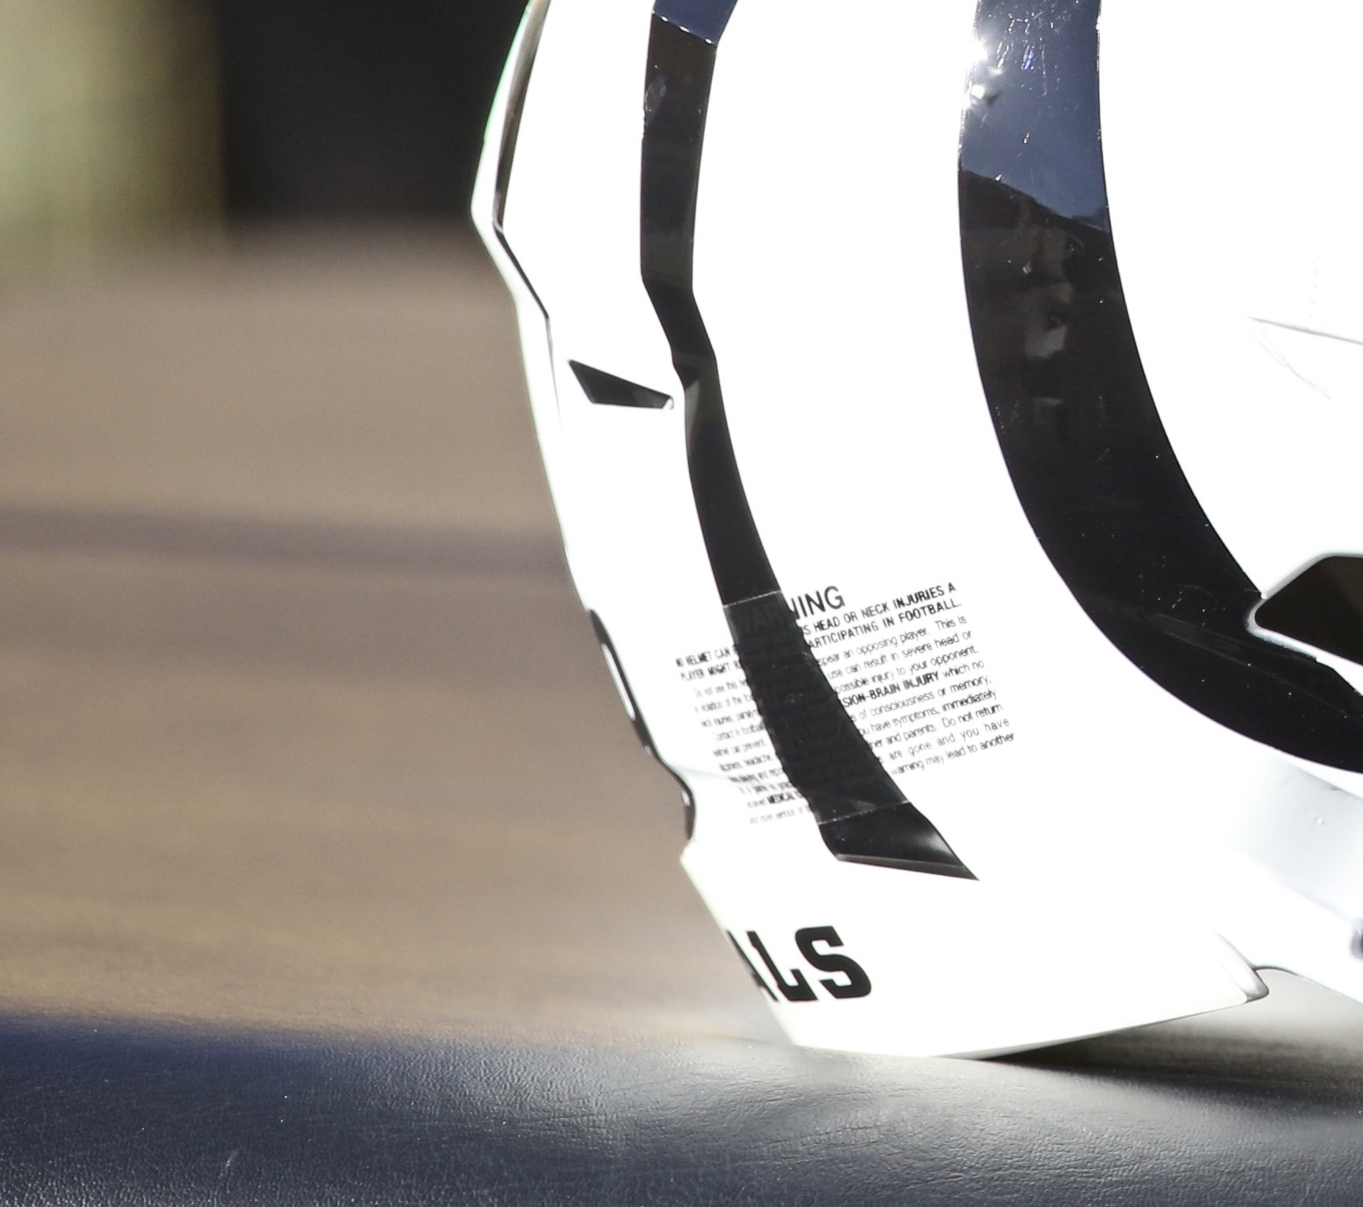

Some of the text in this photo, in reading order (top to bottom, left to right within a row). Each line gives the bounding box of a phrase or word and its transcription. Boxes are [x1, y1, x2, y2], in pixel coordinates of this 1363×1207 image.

[806, 620, 879, 649] ARTICIPATING
[882, 616, 895, 628] IN
[898, 598, 962, 623] FOOTBALL.
[813, 616, 840, 633] HEAD
[843, 611, 858, 624] OR
[861, 601, 890, 619] NECK
[892, 585, 945, 609] INJURIES
[948, 582, 957, 593] A
[827, 669, 843, 680] use
[845, 663, 862, 675] can
[863, 653, 889, 669] result
[890, 651, 900, 661] in
[901, 642, 933, 658] severe
[934, 635, 960, 652] head
[961, 630, 972, 642] or
[844, 650, 854, 659] an
[857, 636, 899, 656] opposing
[934, 616, 957, 631] This
[958, 615, 967, 624] is
[834, 677, 869, 694] possible
[871, 669, 895, 684] injury
[896, 666, 906, 676] to
[908, 661, 928, 675] your
[930, 645, 979, 667] opponent.
[903, 670, 940, 690] INJURY
[942, 663, 971, 679] which
[972, 659, 985, 670] no
[859, 710, 867, 720] of
[870, 691, 935, 717] consciousness
[937, 686, 947, 697] or
[949, 674, 992, 693] memory,
[870, 721, 892, 732] have
[892, 706, 941, 727] symptoms,
[941, 687, 997, 712] immediately
[885, 732, 902, 746] and
[941, 715, 957, 728] Do
[958, 711, 973, 724] not
[975, 703, 1003, 719] return
[889, 749, 903, 761] are
[908, 741, 932, 757] gone
[937, 733, 956, 746] and
[960, 726, 980, 742] you
[984, 717, 1010, 732] have
[890, 759, 925, 776] warning
[925, 753, 945, 767] may
[945, 747, 967, 760] lead
[967, 744, 978, 754] to
[979, 732, 1015, 750] another
